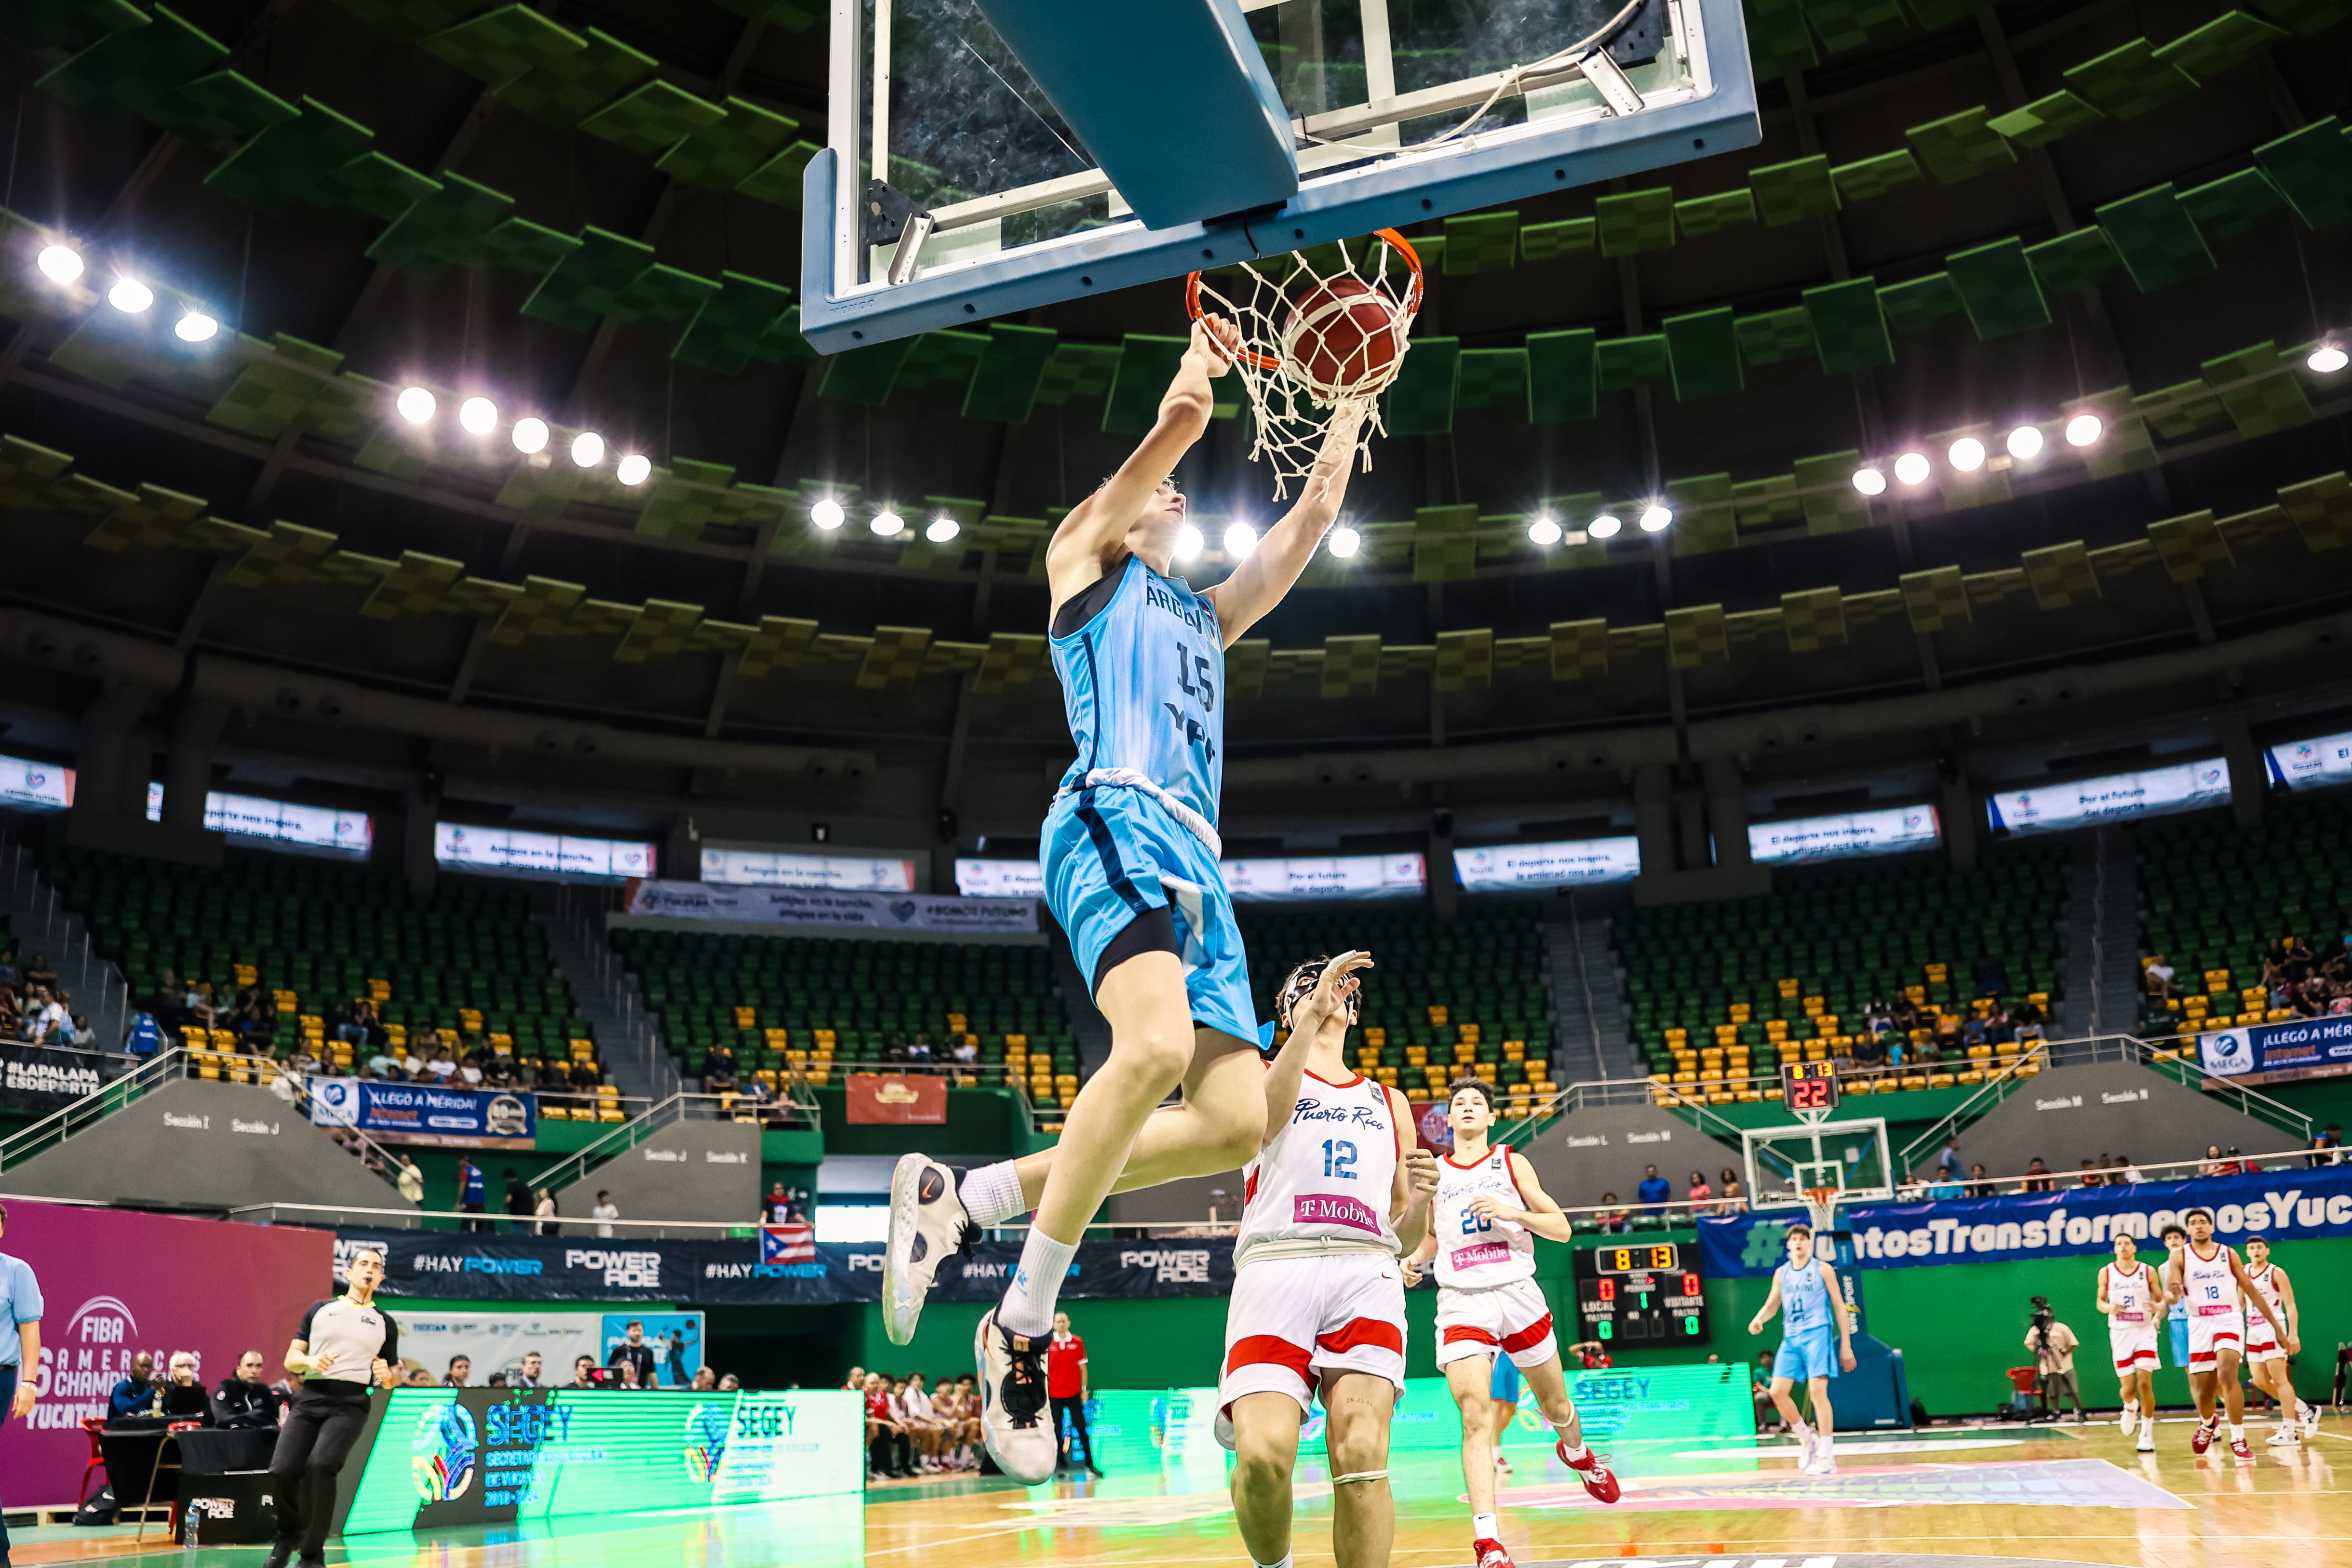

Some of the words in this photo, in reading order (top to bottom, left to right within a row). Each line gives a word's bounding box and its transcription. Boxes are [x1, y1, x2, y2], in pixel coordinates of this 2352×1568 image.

[1176, 641, 1214, 713] 15
[2310, 1028, 2321, 1041] A
[1793, 1080, 1828, 1108] 22
[1292, 1098, 1348, 1125] Puerto
[1351, 1106, 1385, 1130] Rico
[269, 1122, 280, 1135] J
[678, 1150, 687, 1162] J
[1322, 1139, 1357, 1180] 12
[1442, 1182, 1475, 1203] Puerto
[1478, 1176, 1503, 1191] Rico
[1318, 1199, 1376, 1229] Mobile
[565, 1248, 662, 1271] POWER
[1120, 1249, 1210, 1269] POWER
[1466, 1246, 1508, 1264] Mobile
[604, 1268, 660, 1288] ADE
[1157, 1267, 1210, 1283] ADE
[1683, 1273, 1700, 1297] 0
[1599, 1278, 1615, 1301] 0
[2205, 1286, 2219, 1300] 18
[1640, 1291, 1648, 1310] 1
[2124, 1296, 2135, 1308] 21
[81, 1316, 125, 1343] FIBA
[1598, 1320, 1613, 1340] 0
[1685, 1315, 1700, 1335] 0
[1576, 1377, 1651, 1401] SEGEY
[737, 1406, 796, 1438] SEGEY
